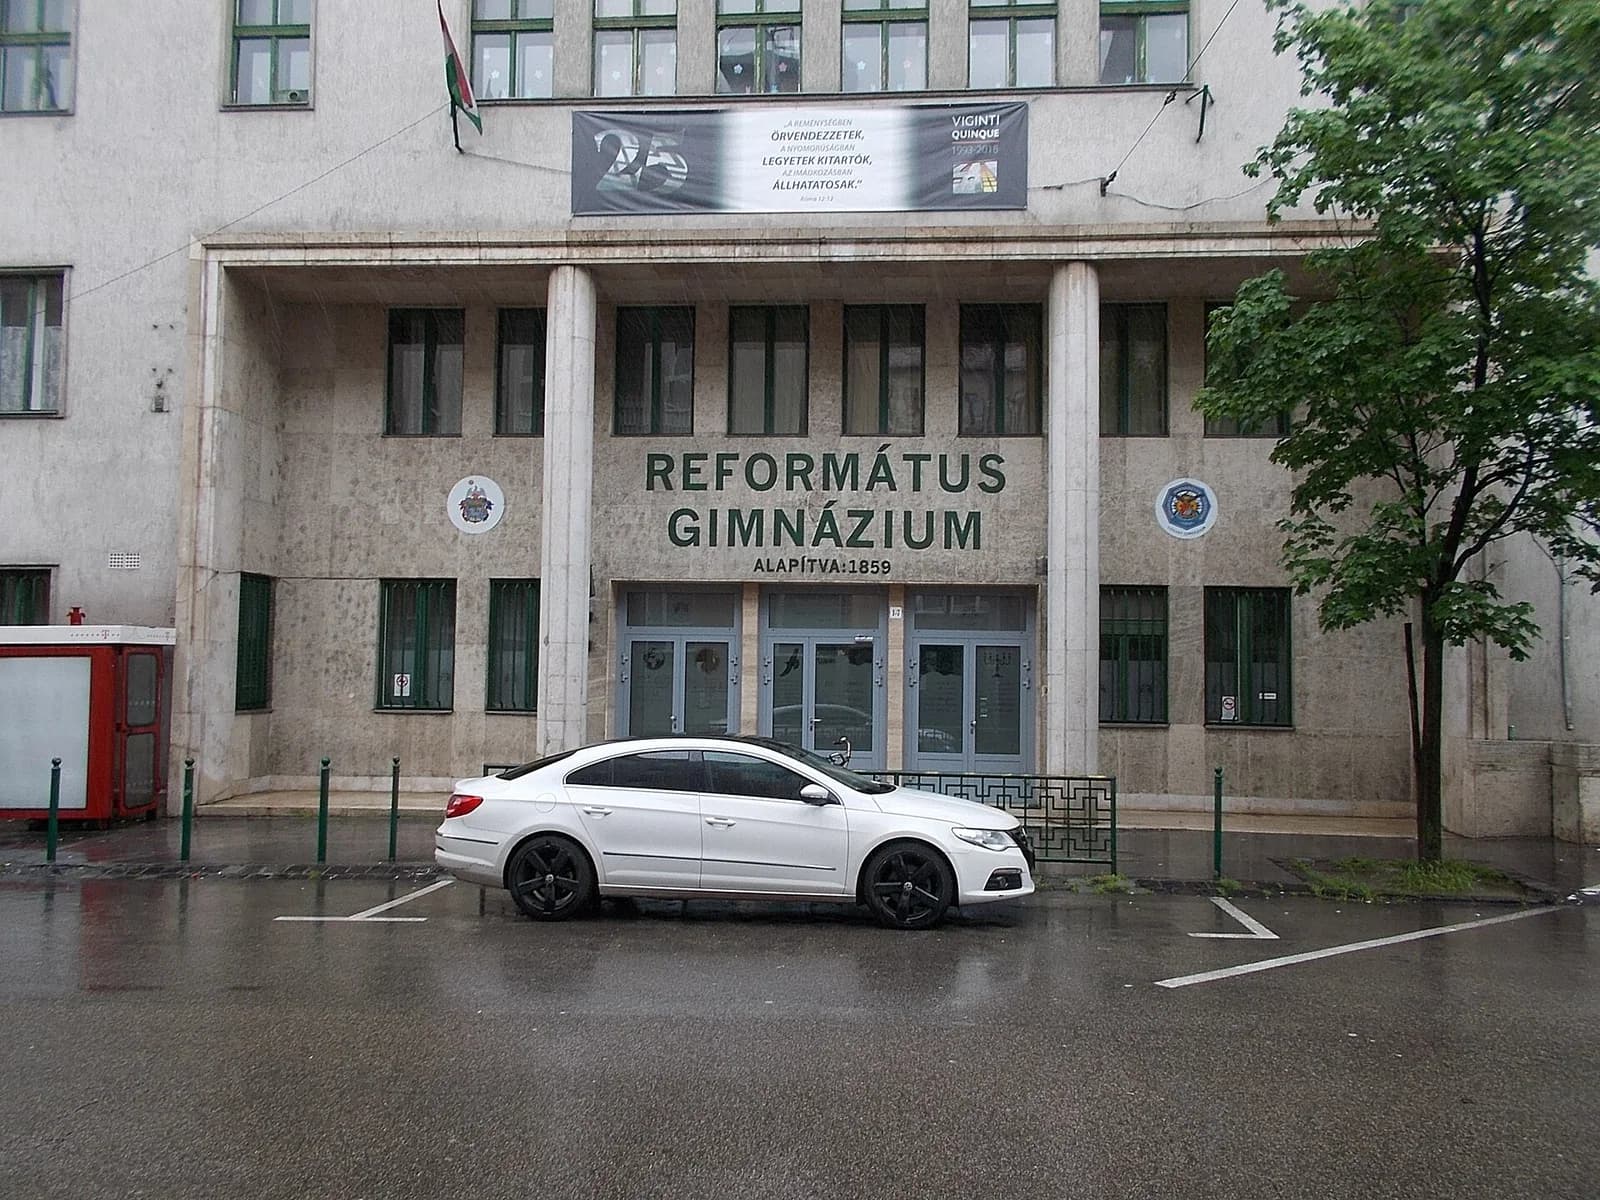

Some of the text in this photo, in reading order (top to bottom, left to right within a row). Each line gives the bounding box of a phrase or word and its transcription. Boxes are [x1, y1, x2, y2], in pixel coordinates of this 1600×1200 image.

[951, 114, 1000, 127] VIGINTI
[771, 129, 865, 141] ÖRVENDEZZETEK,
[951, 128, 1000, 141] QUINQUE
[594, 127, 689, 194] 25
[762, 154, 873, 166] LEGYETEK KITARTÓK,
[645, 443, 1006, 494] REFORMÁTUS
[667, 499, 982, 550] GIMNÁZIUM
[753, 555, 892, 575] ALAPÍTVA:1859
